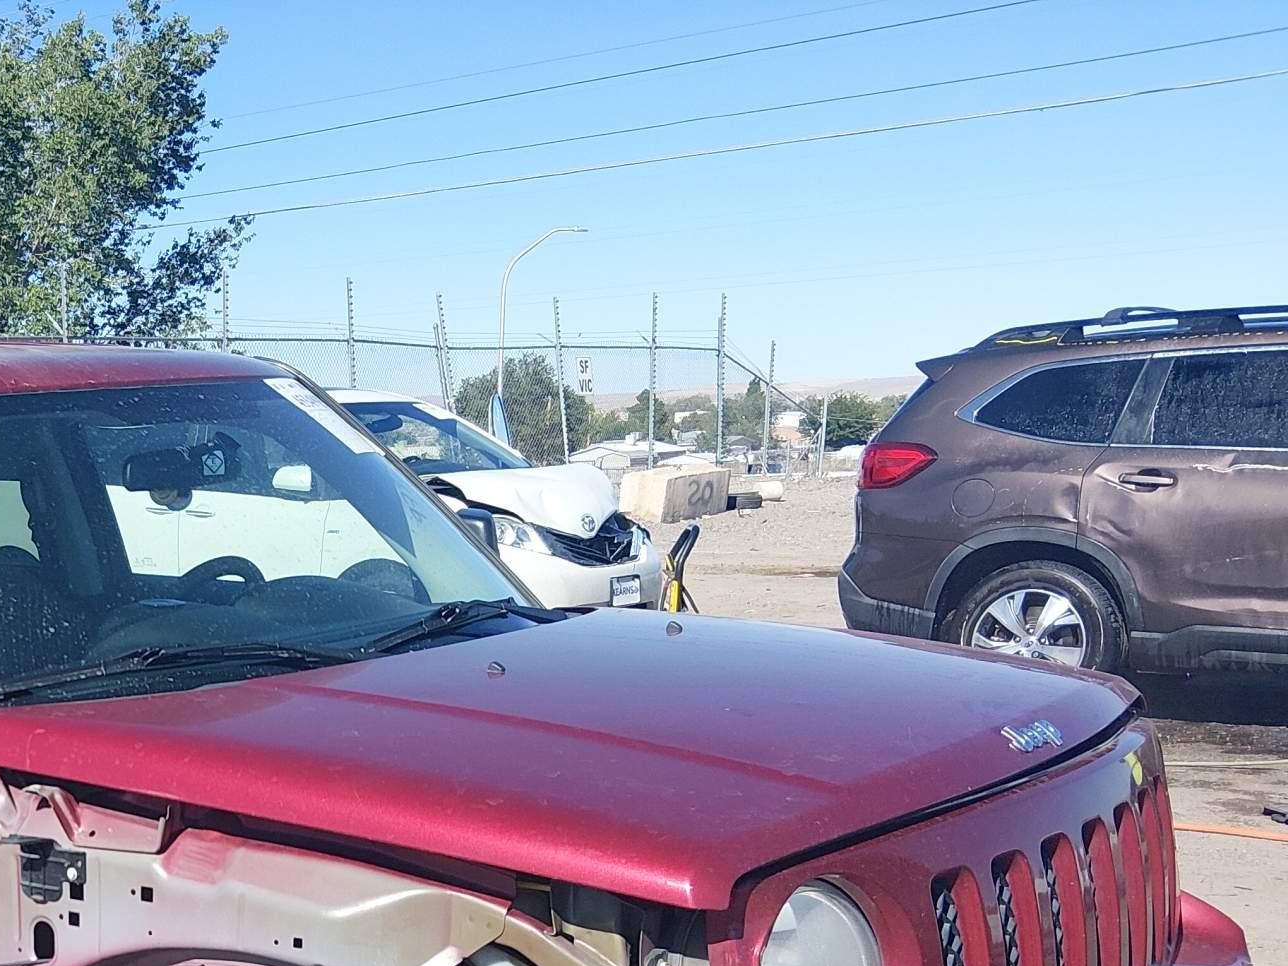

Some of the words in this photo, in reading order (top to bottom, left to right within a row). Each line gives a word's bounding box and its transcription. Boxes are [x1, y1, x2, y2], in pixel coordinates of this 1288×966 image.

[579, 359, 589, 374] SF
[578, 378, 593, 392] VIC
[687, 479, 714, 506] 20
[1000, 719, 1064, 752] Jeep
